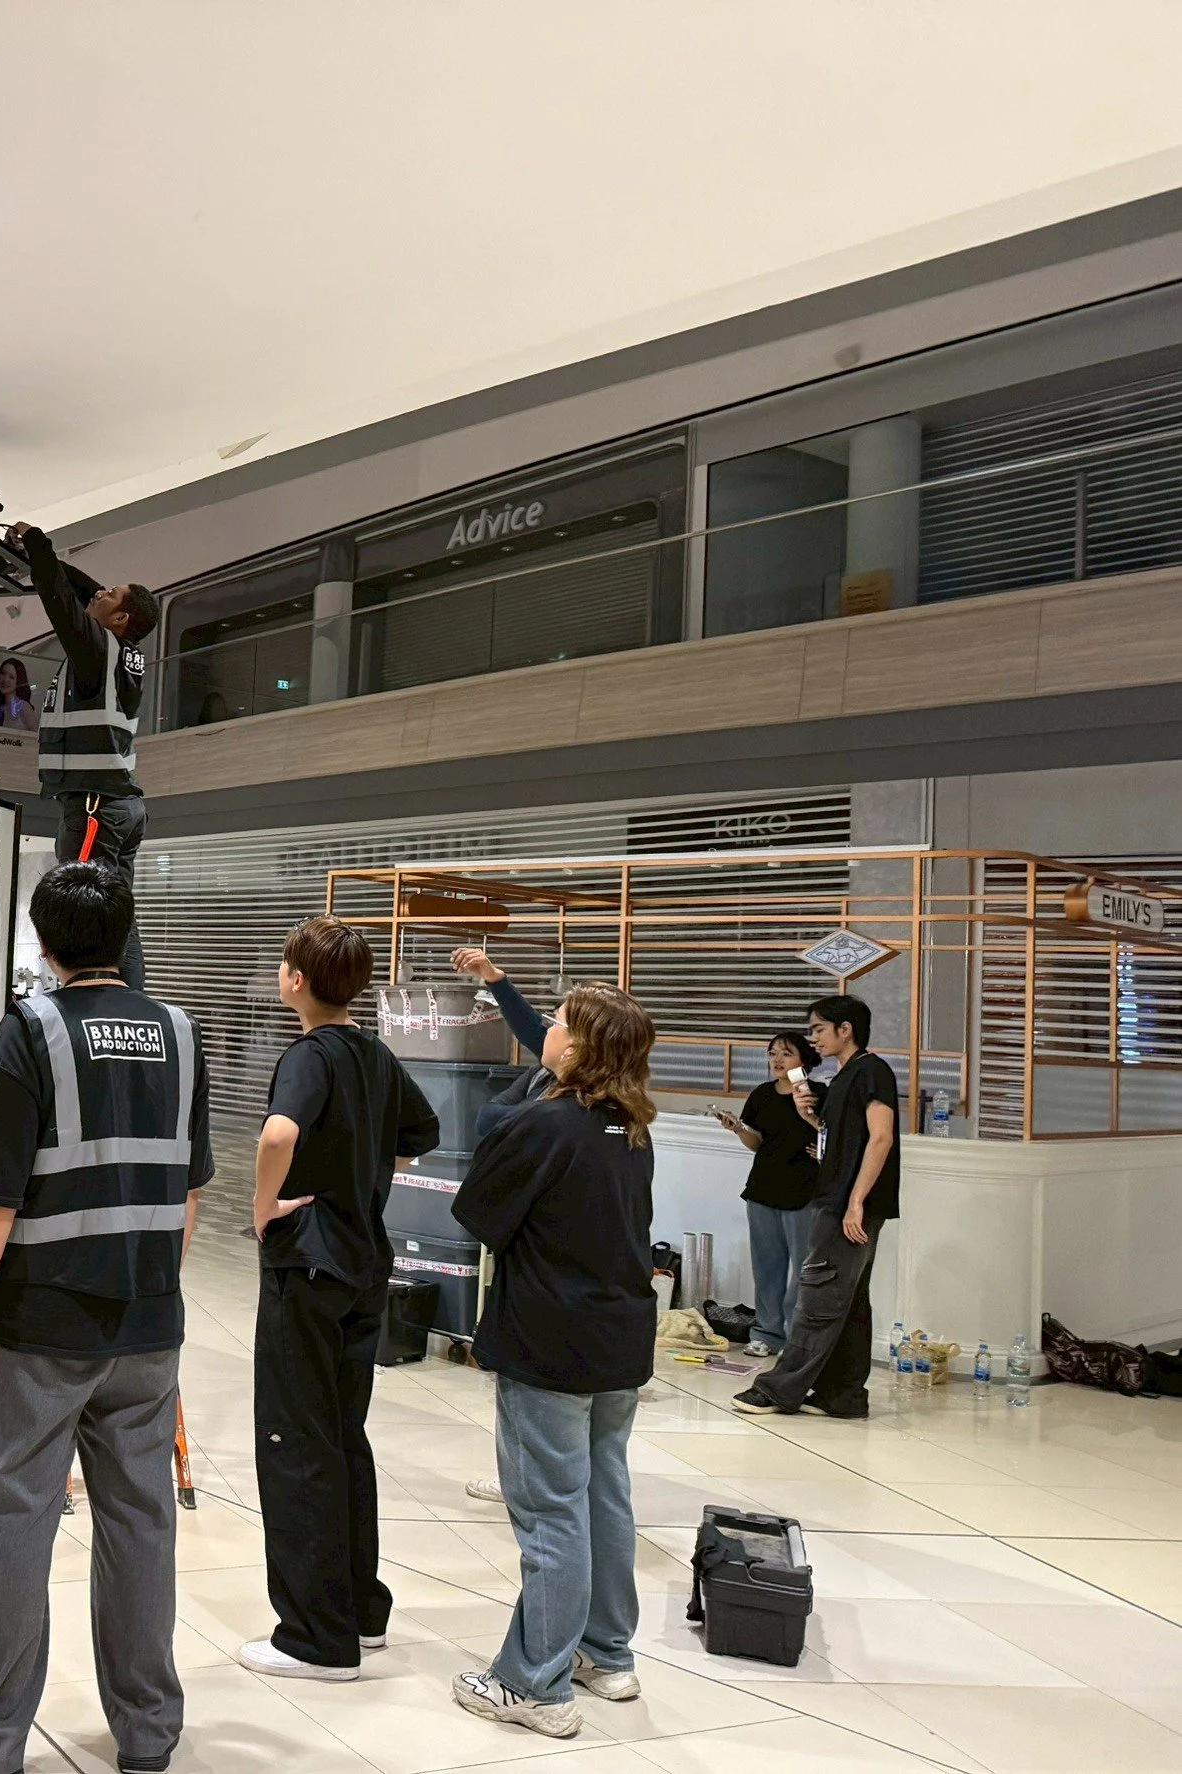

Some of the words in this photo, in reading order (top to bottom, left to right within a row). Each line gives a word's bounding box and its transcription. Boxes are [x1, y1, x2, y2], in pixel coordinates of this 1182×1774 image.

[446, 501, 544, 550] Advice
[714, 813, 792, 838] KIKO
[1102, 893, 1152, 926] EMILY'S
[89, 1025, 159, 1042] BRANCH
[93, 1039, 161, 1053] PRODUCTION
